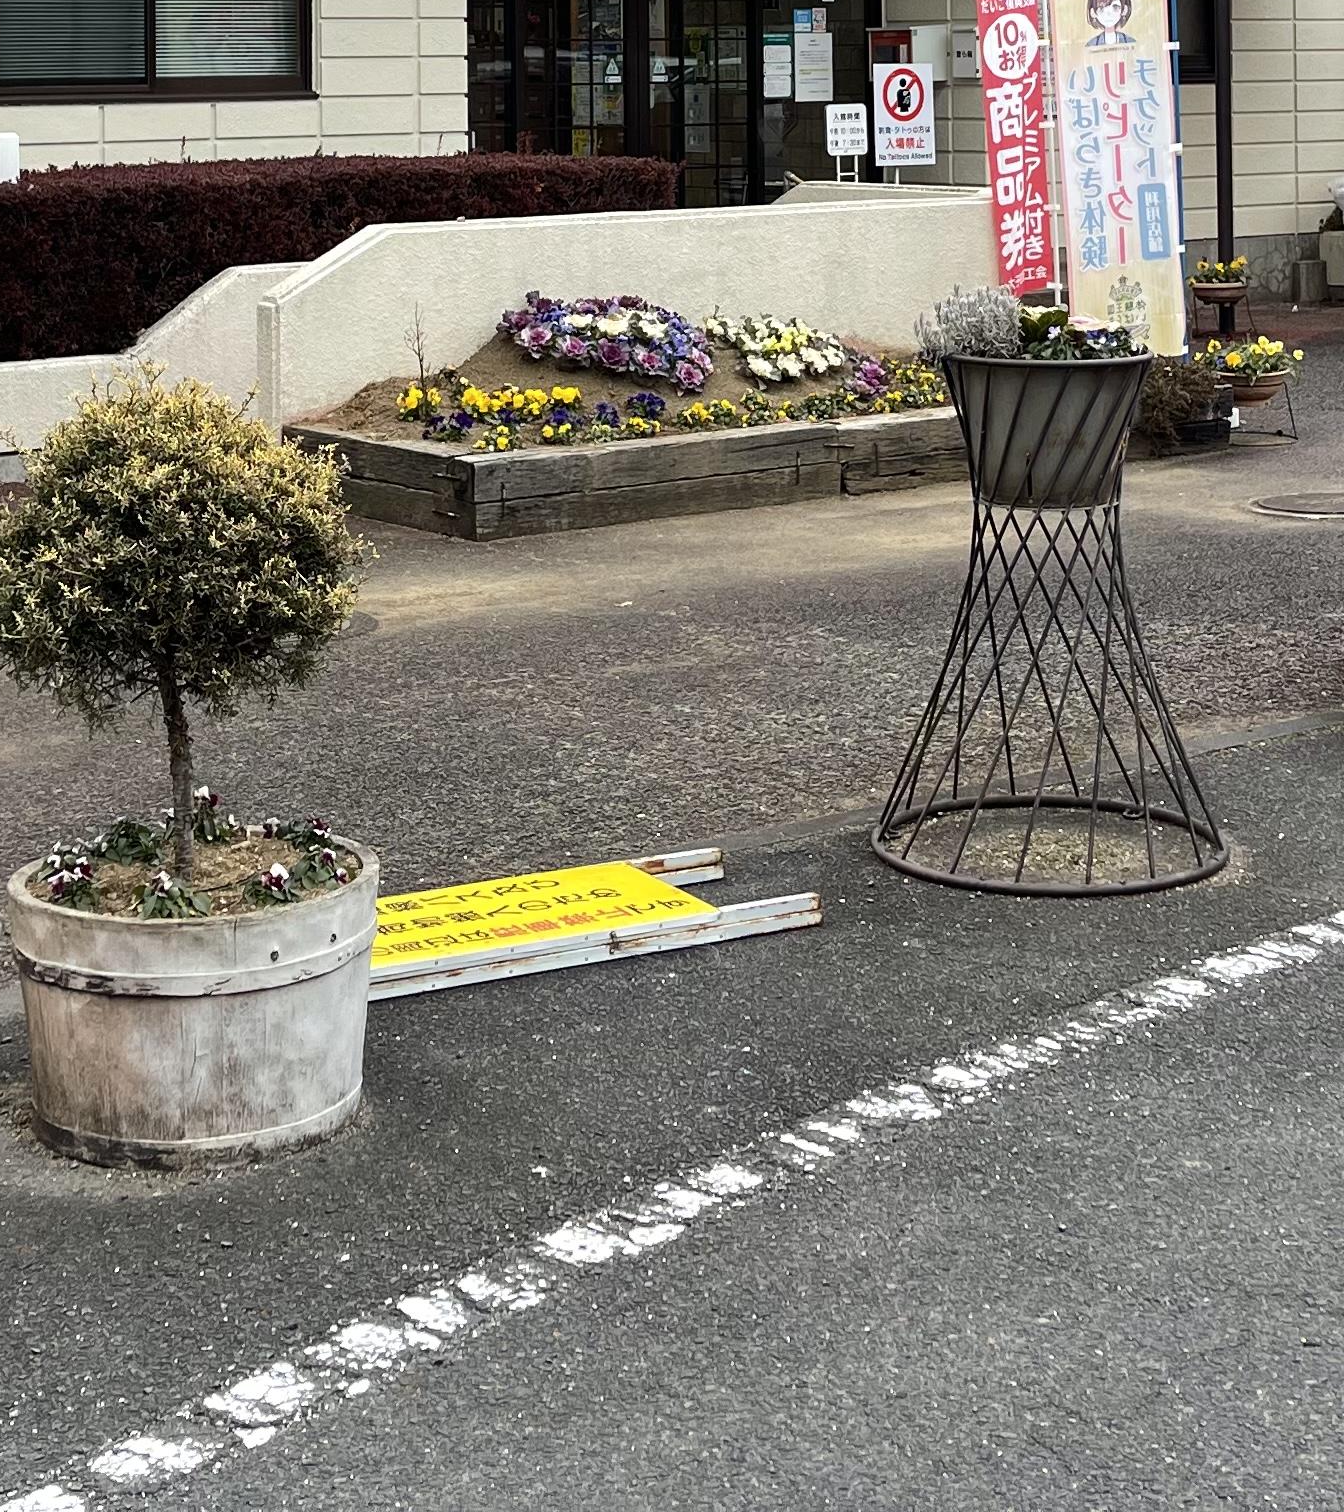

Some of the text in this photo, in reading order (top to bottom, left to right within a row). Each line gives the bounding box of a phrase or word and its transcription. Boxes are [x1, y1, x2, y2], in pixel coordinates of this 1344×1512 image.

[885, 137, 926, 149] 入場禁止
[986, 82, 1025, 271] 商品券
[1022, 72, 1045, 260] プレミアム付き
